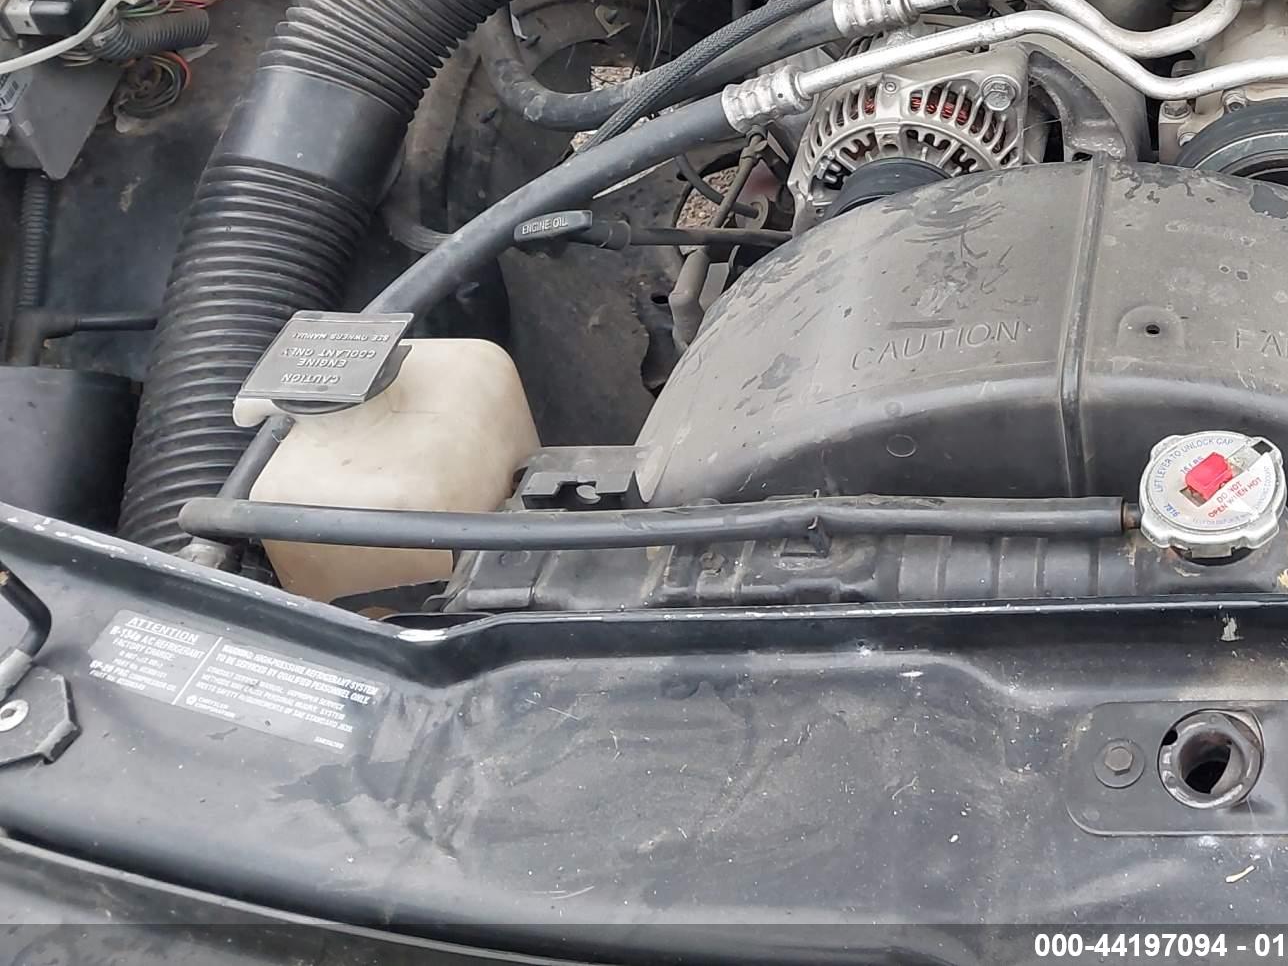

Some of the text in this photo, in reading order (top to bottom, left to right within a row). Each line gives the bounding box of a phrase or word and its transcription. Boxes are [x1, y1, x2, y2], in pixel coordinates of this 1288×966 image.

[522, 216, 569, 235] ENGINE OIL
[282, 347, 377, 358] COOLANT ONLY
[850, 320, 1023, 372] CAUTION
[297, 358, 348, 368] ENGINE
[280, 373, 341, 384] CAUTION
[1156, 458, 1172, 480] LEVER
[1172, 450, 1182, 460] TO
[1181, 438, 1215, 453] UNLOCK
[1215, 438, 1234, 446] CAP
[1208, 502, 1228, 518] OPEN
[1227, 487, 1249, 505] WHEN
[1247, 477, 1263, 490] HOT
[1216, 481, 1243, 504] DO NOT
[128, 617, 200, 643] ATTENTION
[112, 637, 144, 653] FACTORY
[154, 637, 205, 659] REFRIGERANT
[226, 656, 235, 664] BE
[234, 659, 267, 675] SERVICED
[266, 666, 277, 677] BY
[277, 670, 313, 687] QUALIFIED
[311, 679, 350, 699] PERSONNEL
[349, 680, 379, 696] SYSTEM
[194, 702, 236, 718] CORPORATION
[198, 696, 230, 710] CHRYSLER
